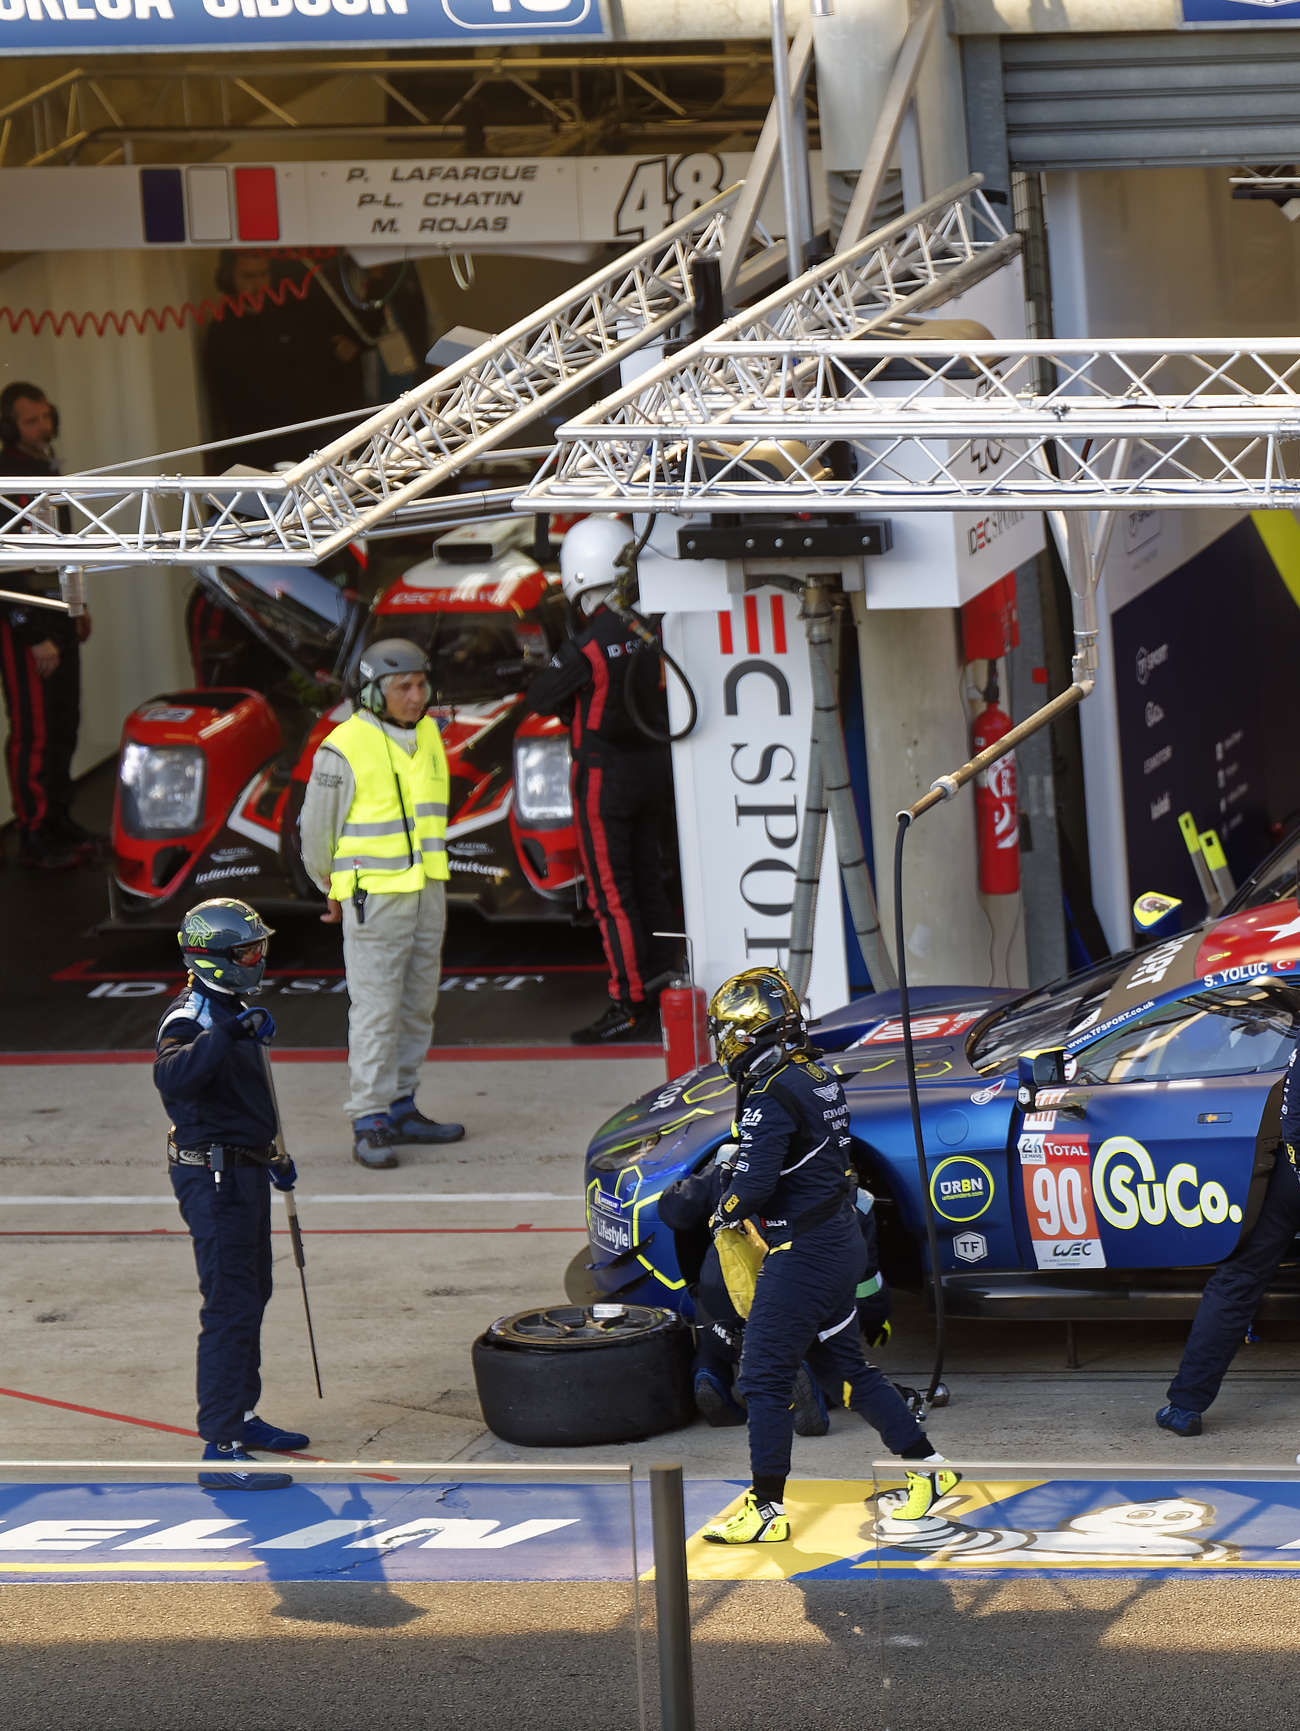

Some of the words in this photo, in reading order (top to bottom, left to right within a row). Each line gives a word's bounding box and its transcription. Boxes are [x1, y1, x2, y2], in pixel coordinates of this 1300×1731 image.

[347, 167, 370, 183] P.
[390, 165, 539, 182] LAFARGUE
[356, 192, 403, 207] P-L.
[422, 190, 524, 206] CHATIN
[615, 152, 724, 241] 48
[371, 217, 400, 233] M.
[418, 216, 510, 232] ROJAS
[1203, 975, 1219, 988] S.
[1066, 1000, 1156, 1050] www.TFSPORT.co.uk
[939, 1177, 984, 1195] URBN
[1032, 1167, 1088, 1236] 90
[597, 1216, 629, 1250] Lifestyle
[960, 1241, 980, 1255] TF
[0, 1518, 581, 1550] ELIN
